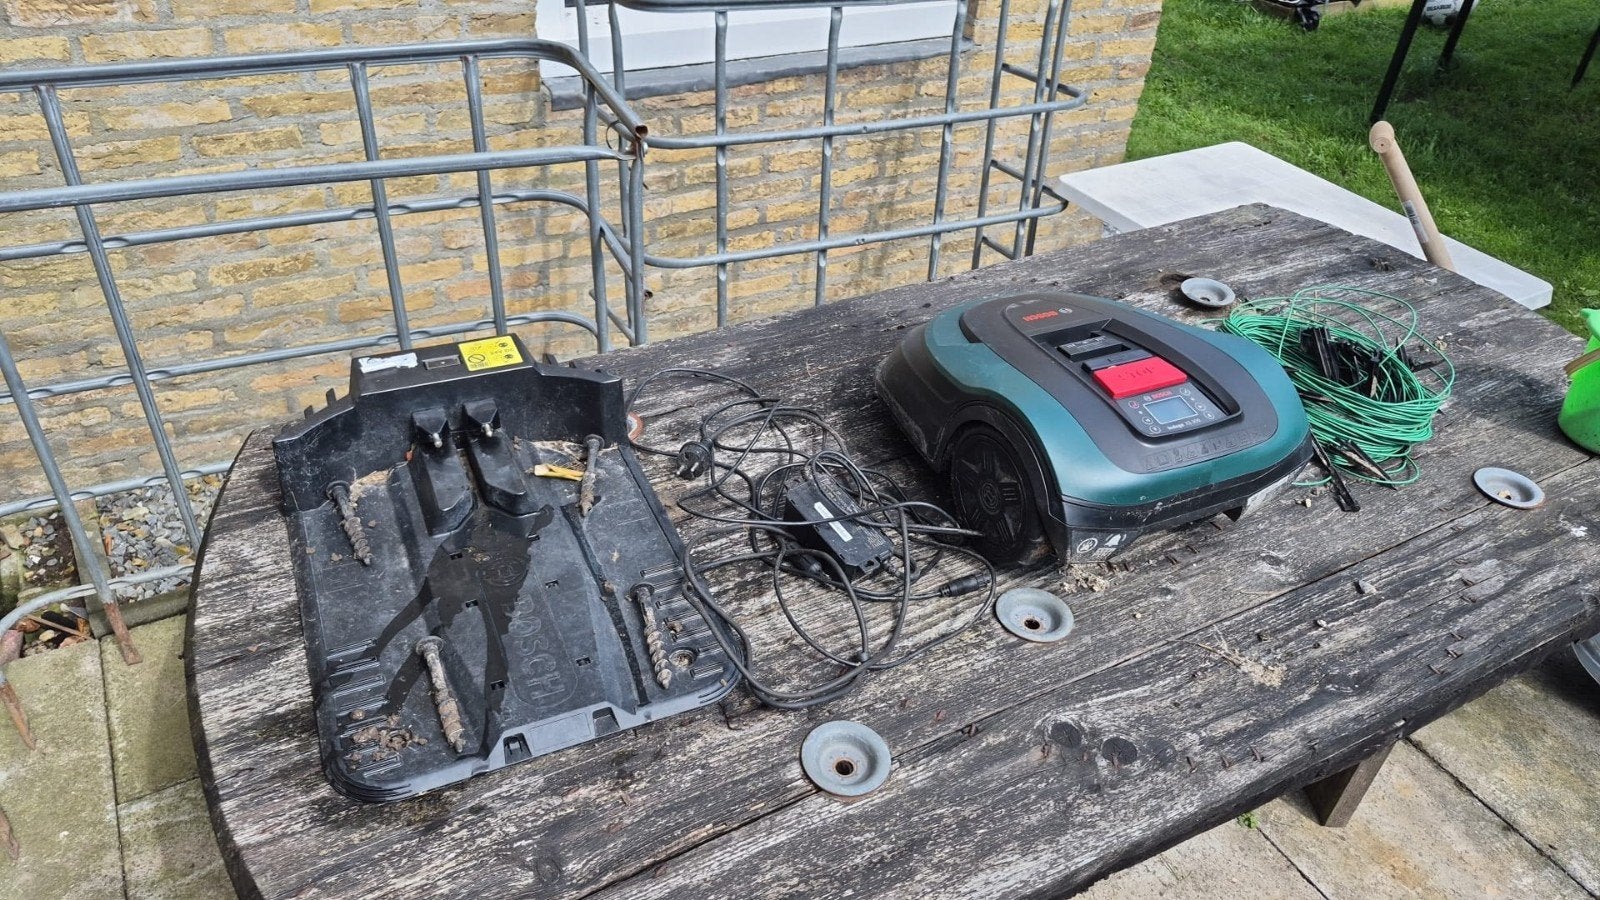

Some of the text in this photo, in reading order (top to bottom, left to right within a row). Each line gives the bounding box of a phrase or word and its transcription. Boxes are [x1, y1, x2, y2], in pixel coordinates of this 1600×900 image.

[1022, 309, 1059, 322] BOSCH
[1117, 366, 1155, 381] STOP
[1150, 390, 1173, 401] BOSCH
[507, 593, 566, 700] BOSCH
